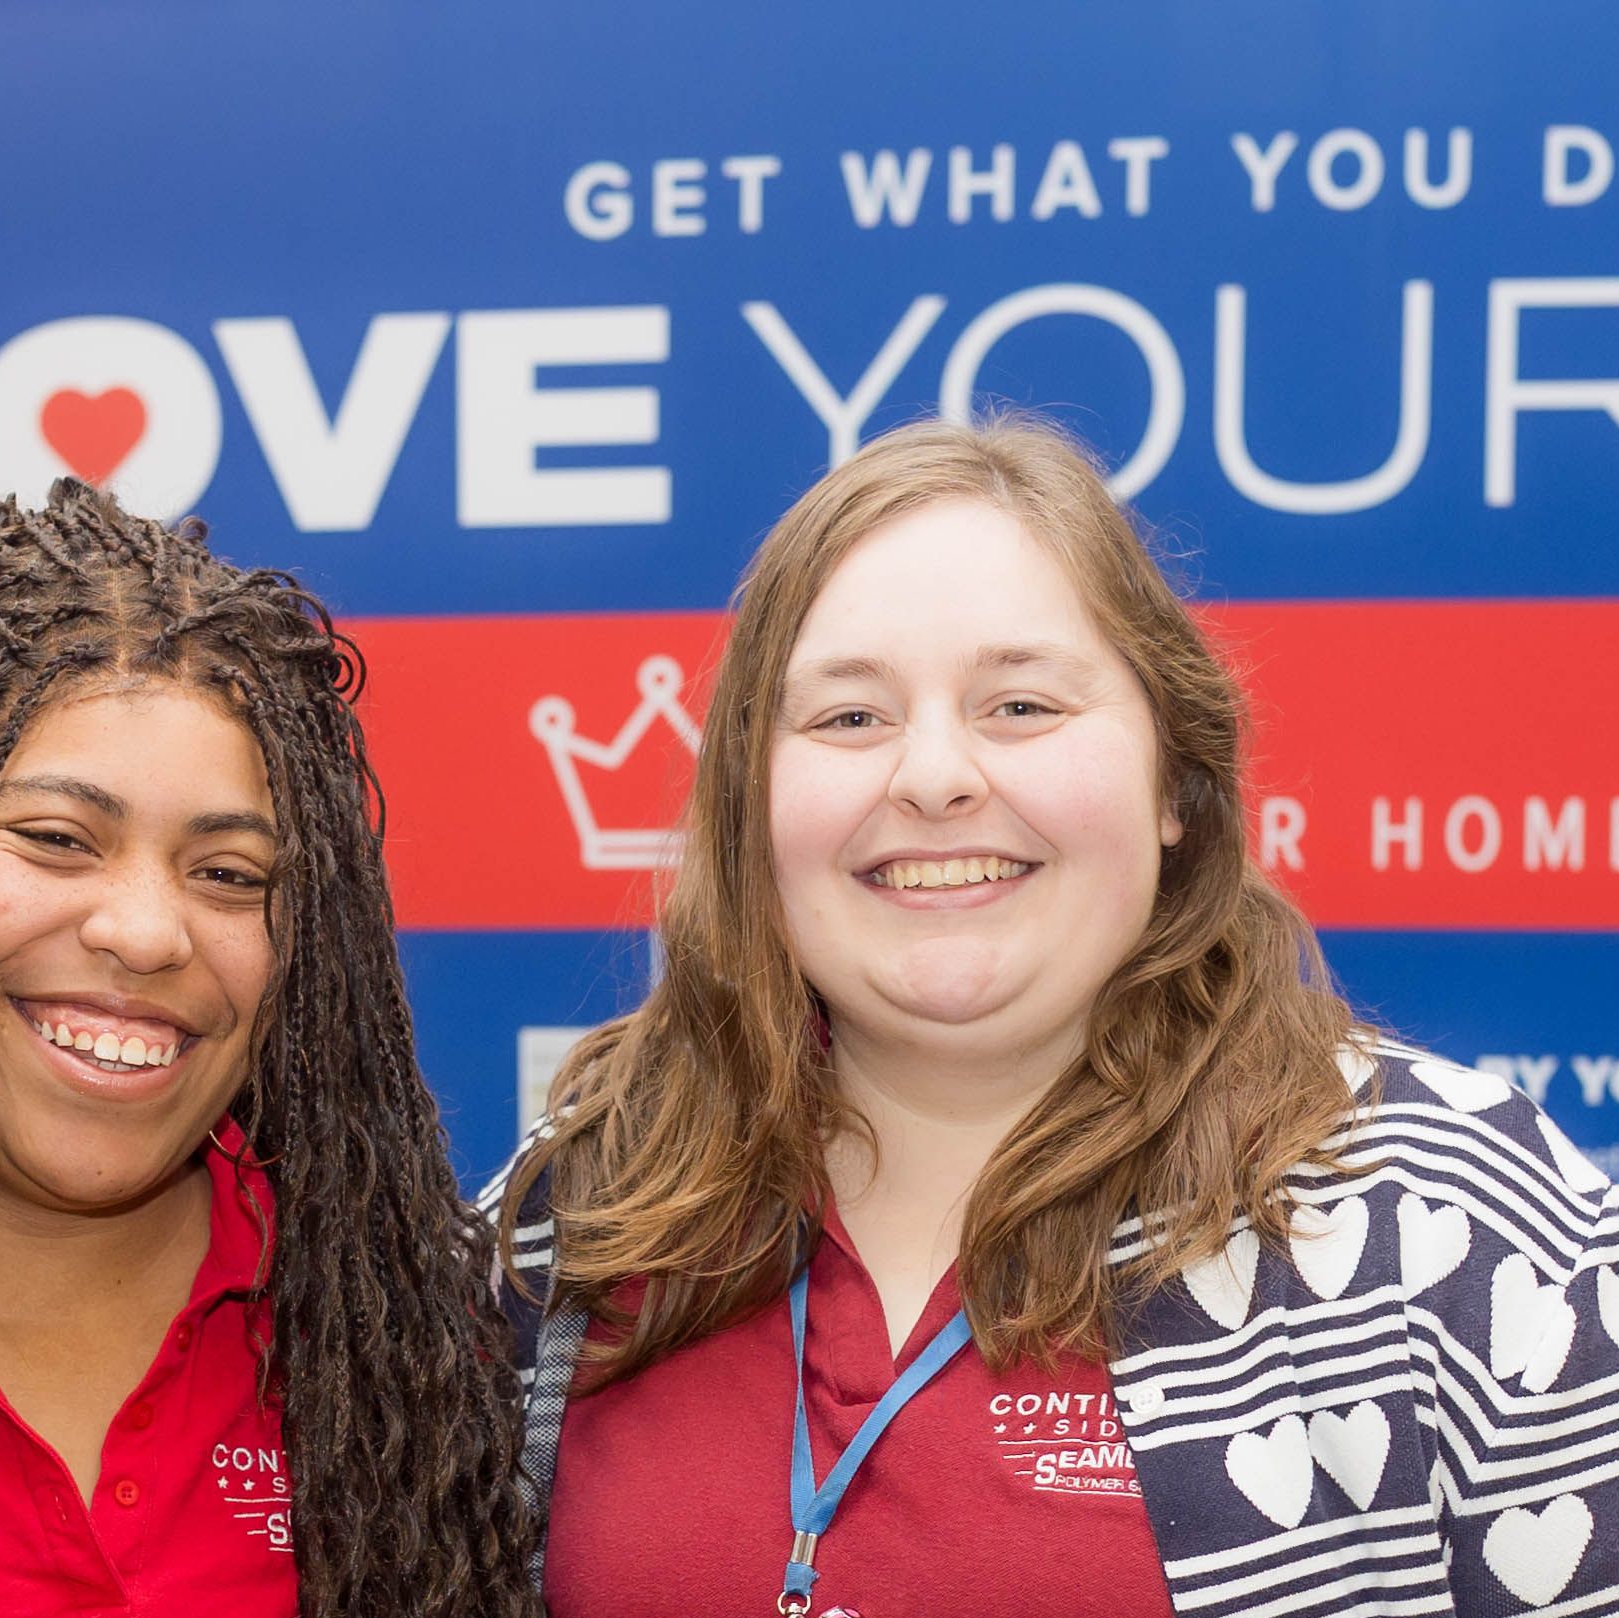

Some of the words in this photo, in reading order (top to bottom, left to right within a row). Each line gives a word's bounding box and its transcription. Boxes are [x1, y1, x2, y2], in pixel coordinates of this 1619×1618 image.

[565, 155, 782, 240] GET
[844, 135, 1170, 229] WHAT
[1231, 126, 1473, 214] YOU
[989, 1391, 1118, 1417] CONTI
[212, 1443, 287, 1473] CON
